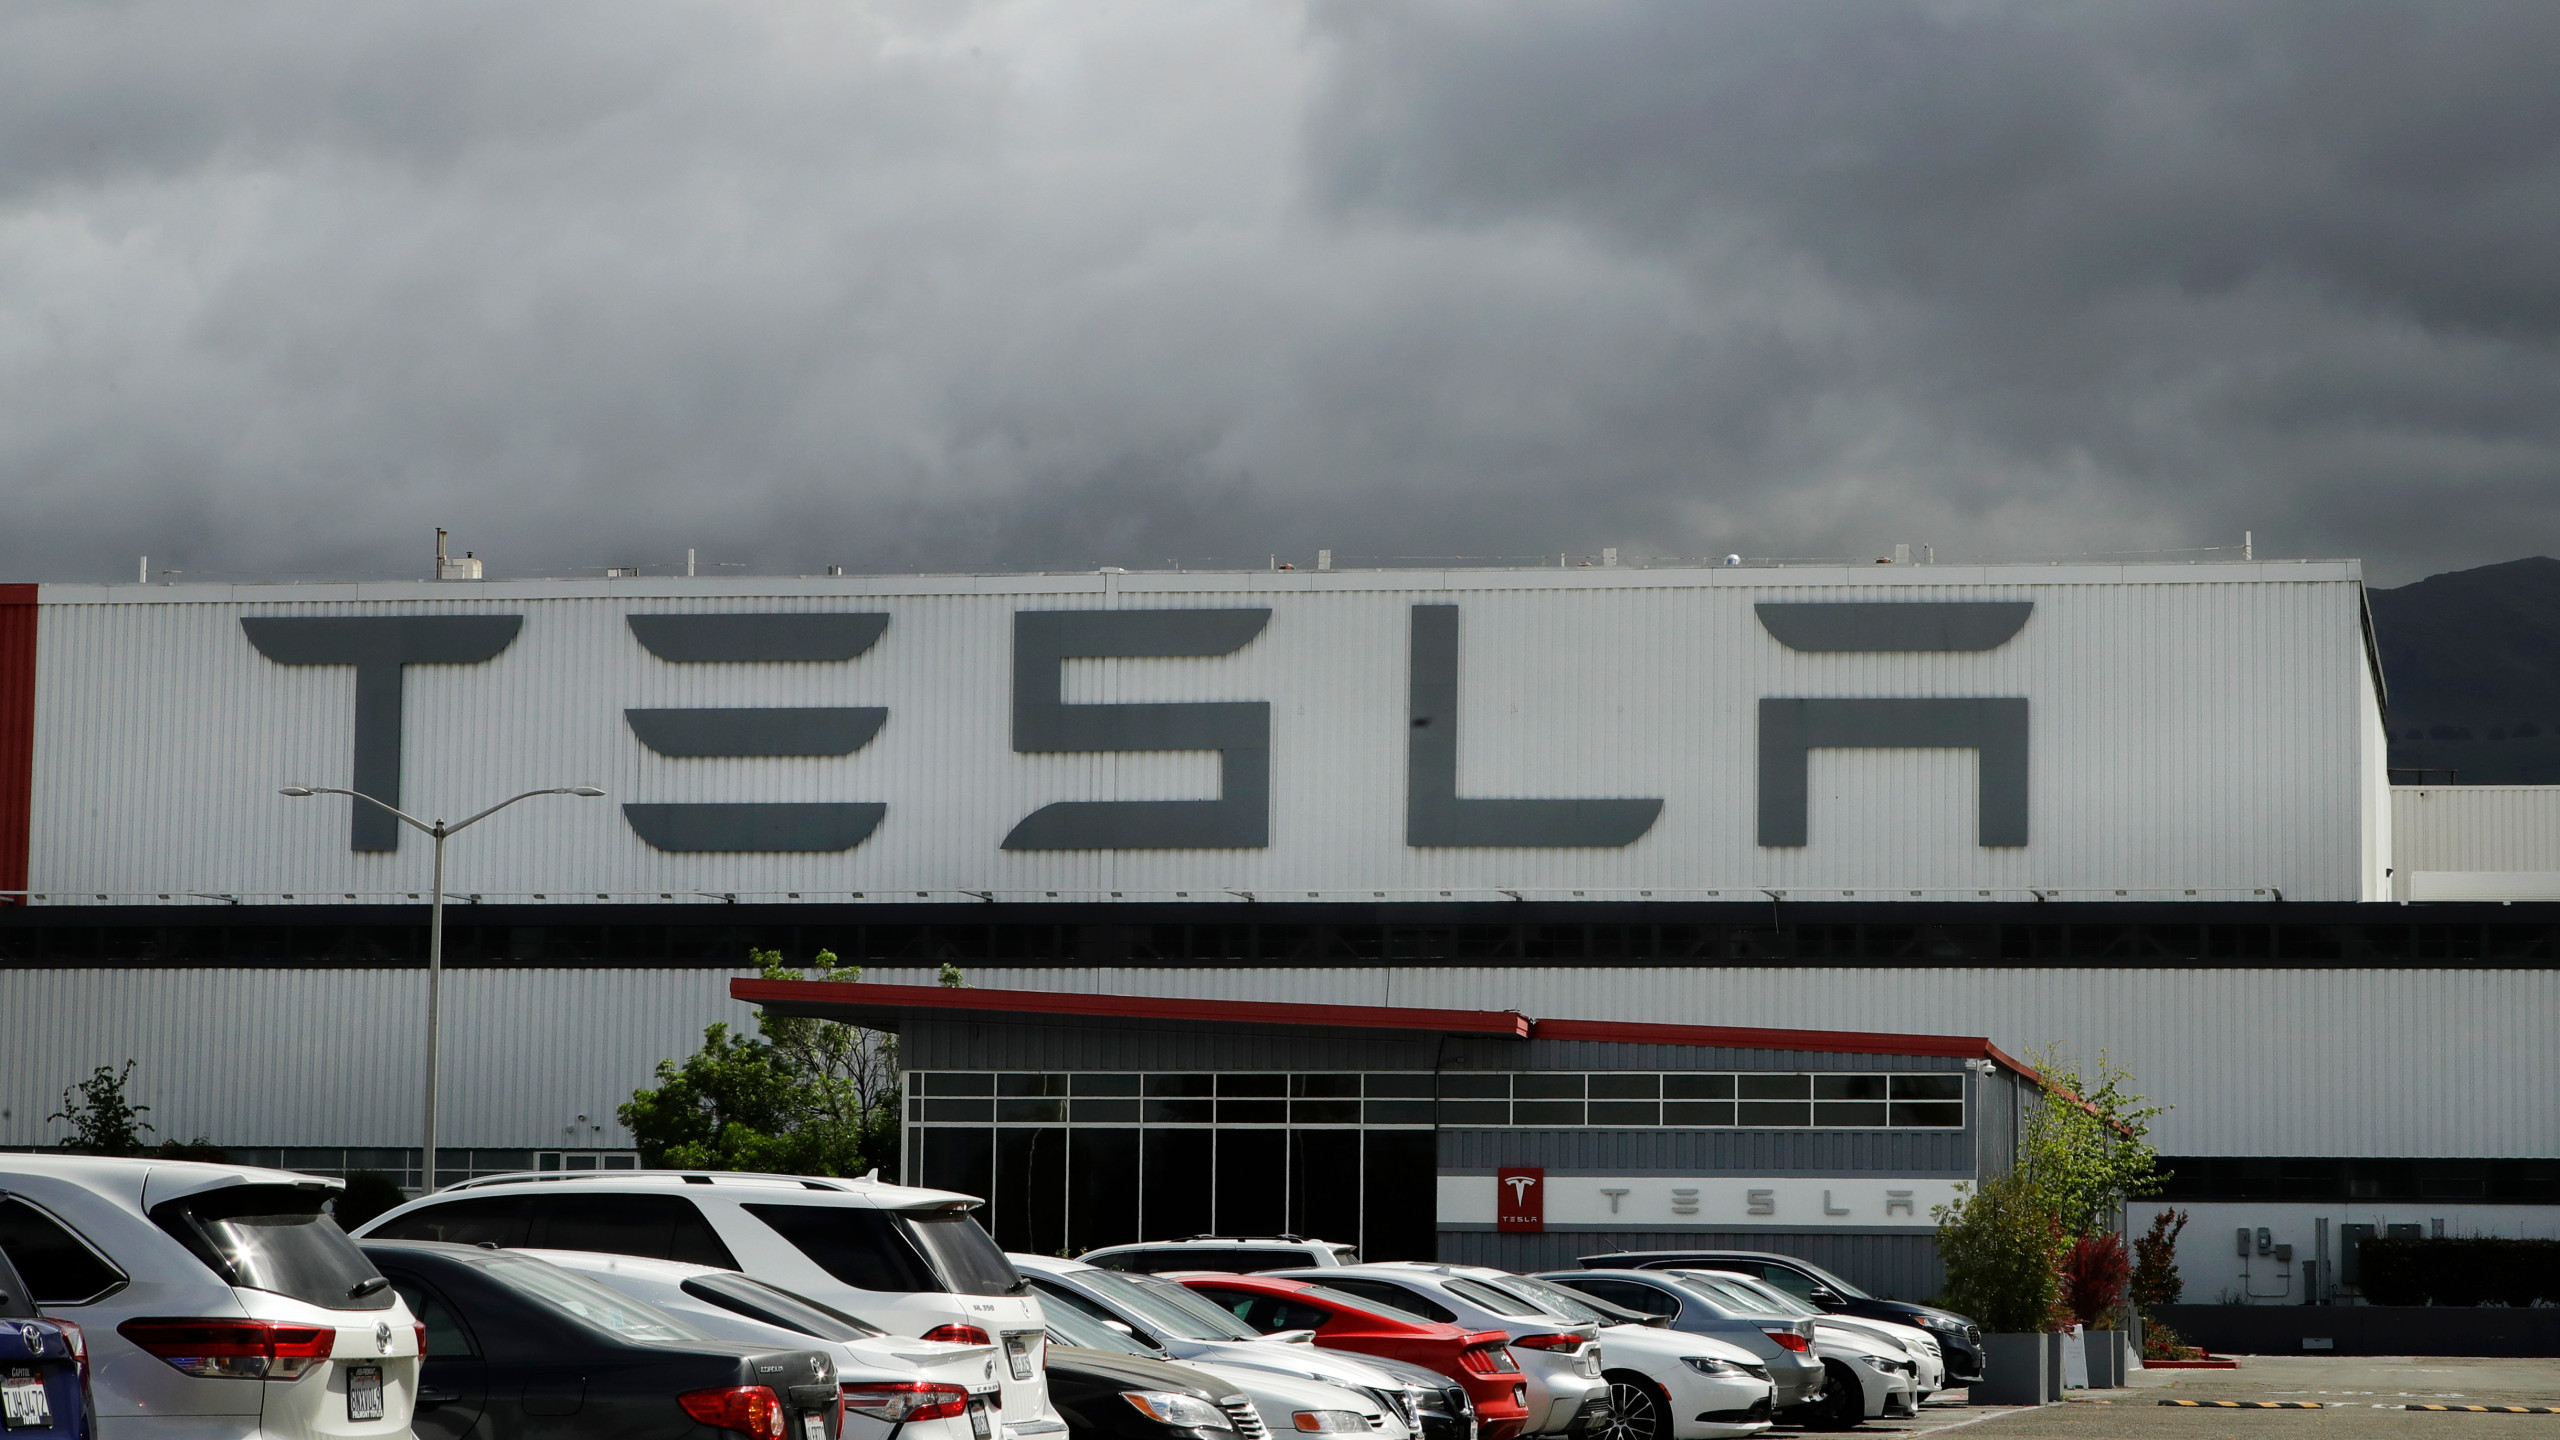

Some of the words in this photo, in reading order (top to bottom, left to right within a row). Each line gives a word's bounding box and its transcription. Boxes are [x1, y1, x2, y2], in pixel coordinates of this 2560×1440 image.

[241, 602, 2034, 852] TESLA
[1600, 1189, 1914, 1215] TESLA
[982, 1304, 995, 1312] 350
[3, 1390, 47, 1417] 7JHJ472
